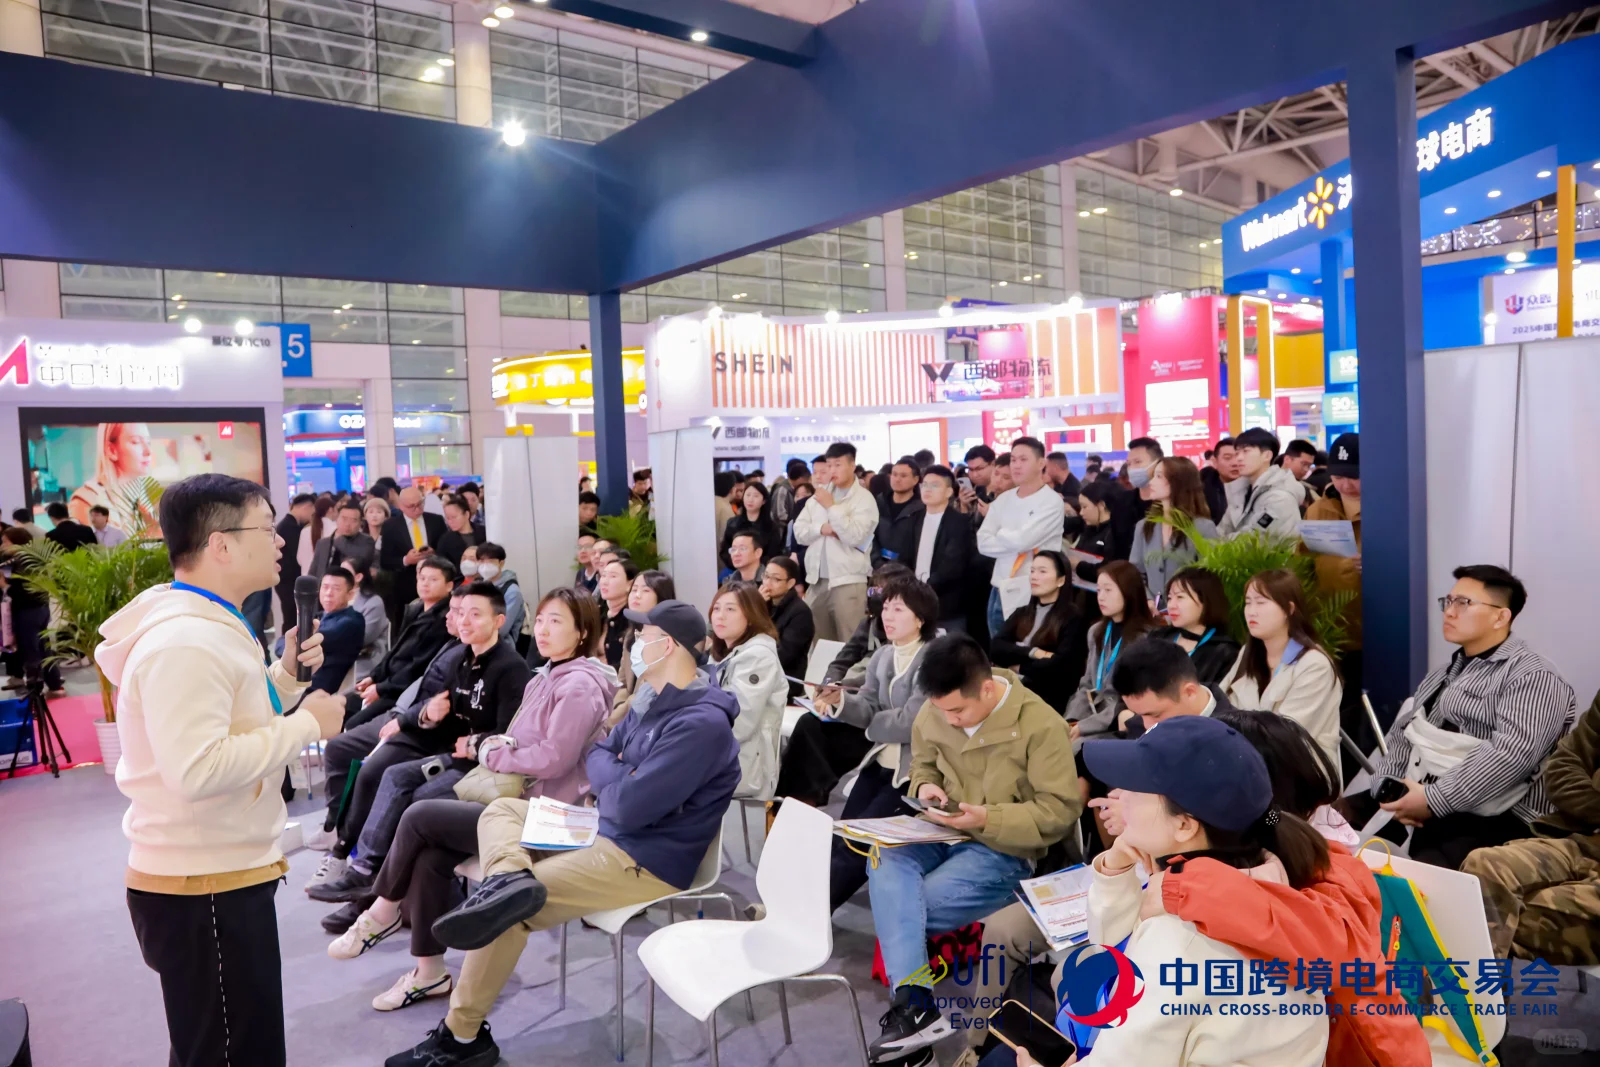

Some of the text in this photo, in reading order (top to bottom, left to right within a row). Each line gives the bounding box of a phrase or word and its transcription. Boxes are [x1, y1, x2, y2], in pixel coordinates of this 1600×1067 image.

[1416, 107, 1492, 172] 球电商
[715, 352, 793, 374] SHEIN
[964, 358, 1052, 380] 西邮物流
